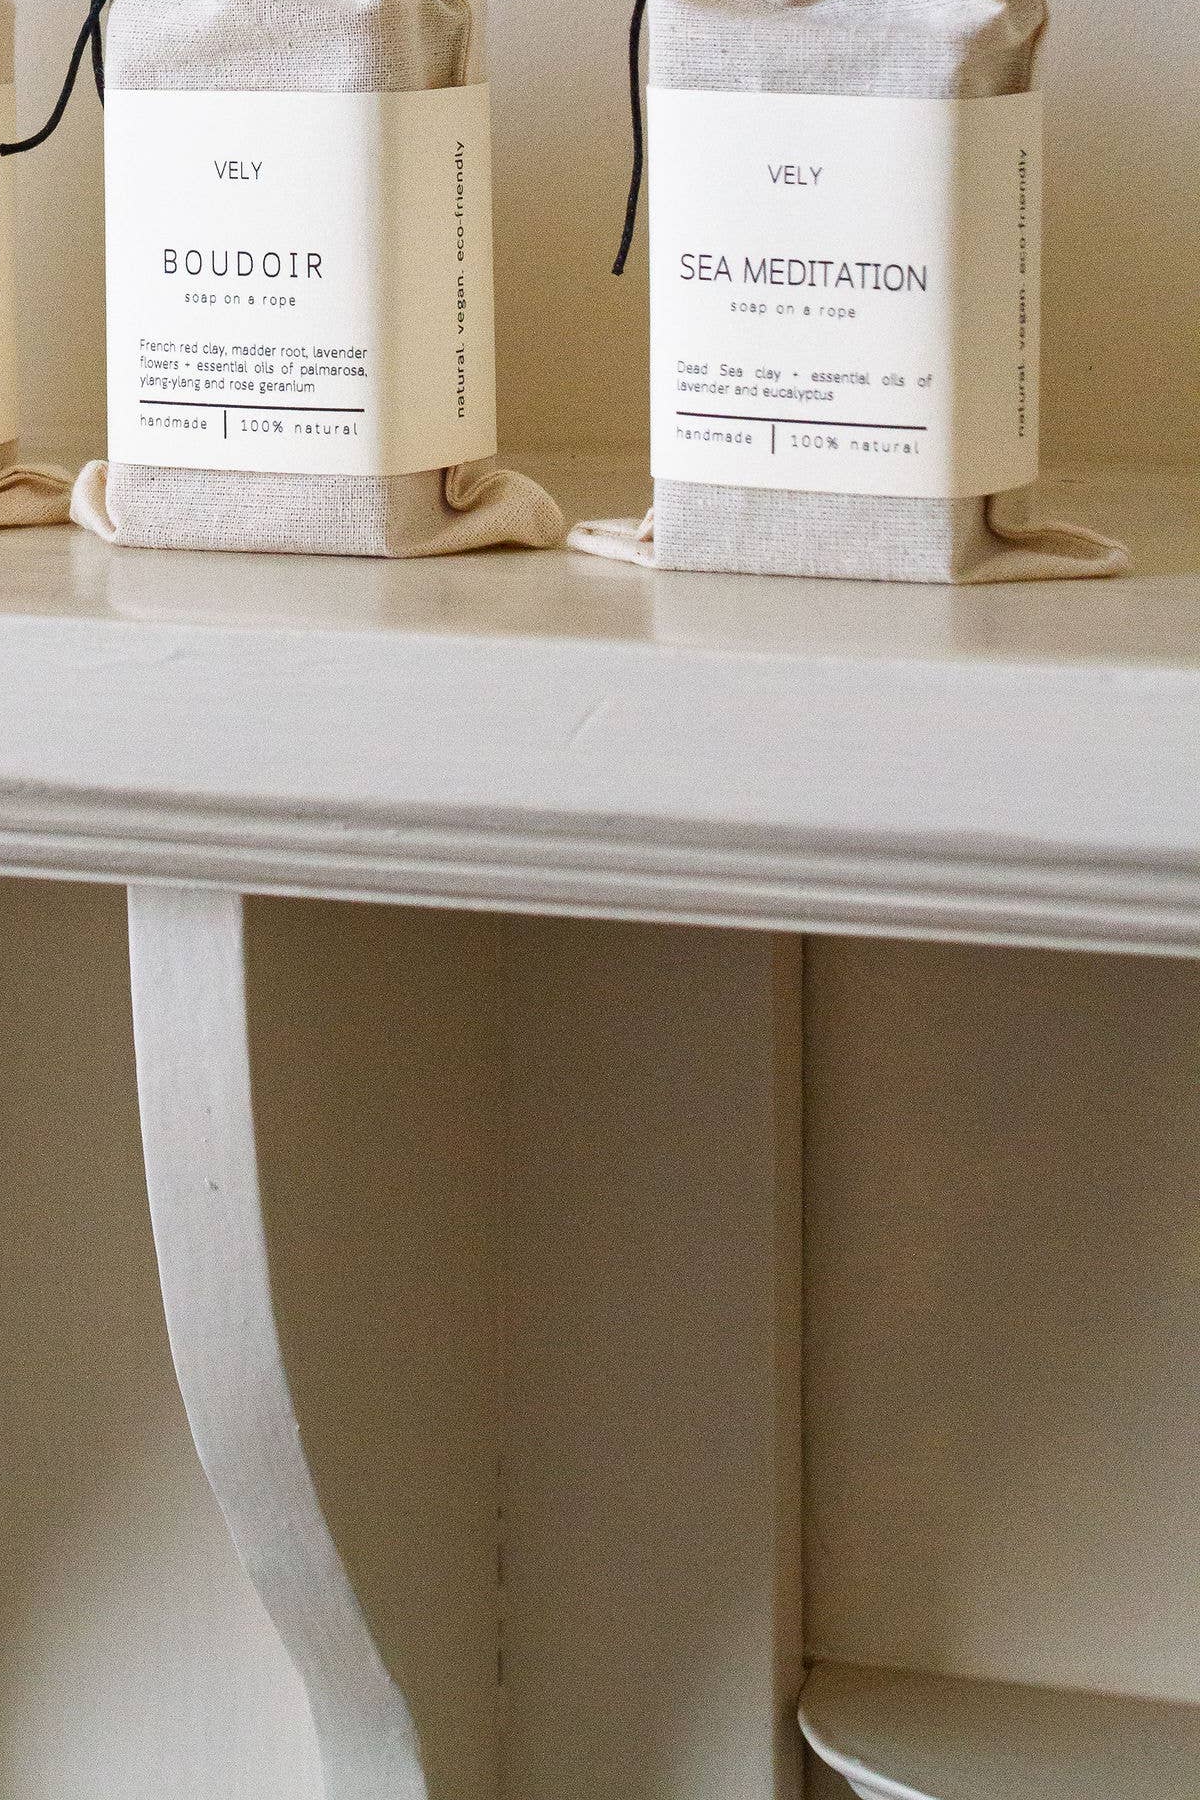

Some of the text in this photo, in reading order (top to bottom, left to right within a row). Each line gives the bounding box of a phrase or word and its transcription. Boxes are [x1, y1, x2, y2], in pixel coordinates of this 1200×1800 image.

[214, 160, 263, 180] VELY
[767, 164, 823, 186] VELY
[455, 140, 465, 262] eco-friendly
[164, 249, 323, 279] BOUDOIR
[679, 253, 928, 292] SEA MEDITATION
[184, 293, 296, 306] soap on a rope
[730, 301, 856, 320] soap on a rope
[140, 339, 368, 359] French red clay, madder root, lavender
[140, 356, 178, 369] flowers
[197, 361, 248, 373] essential
[254, 362, 274, 374] oils
[281, 362, 293, 374] of
[677, 361, 708, 375] Dead
[720, 364, 743, 377] Sea
[755, 366, 781, 382] clay
[811, 372, 870, 385] essential
[881, 373, 904, 386] oils
[917, 374, 932, 387] of
[140, 375, 315, 393] ylang-ylang and rose geranium
[455, 344, 465, 419] natural.
[677, 380, 833, 402] lavender and eucalyptus
[140, 414, 207, 429] handmade
[241, 420, 358, 436] 100% natural
[676, 427, 753, 445] handmade
[791, 435, 919, 454] 100% natural
